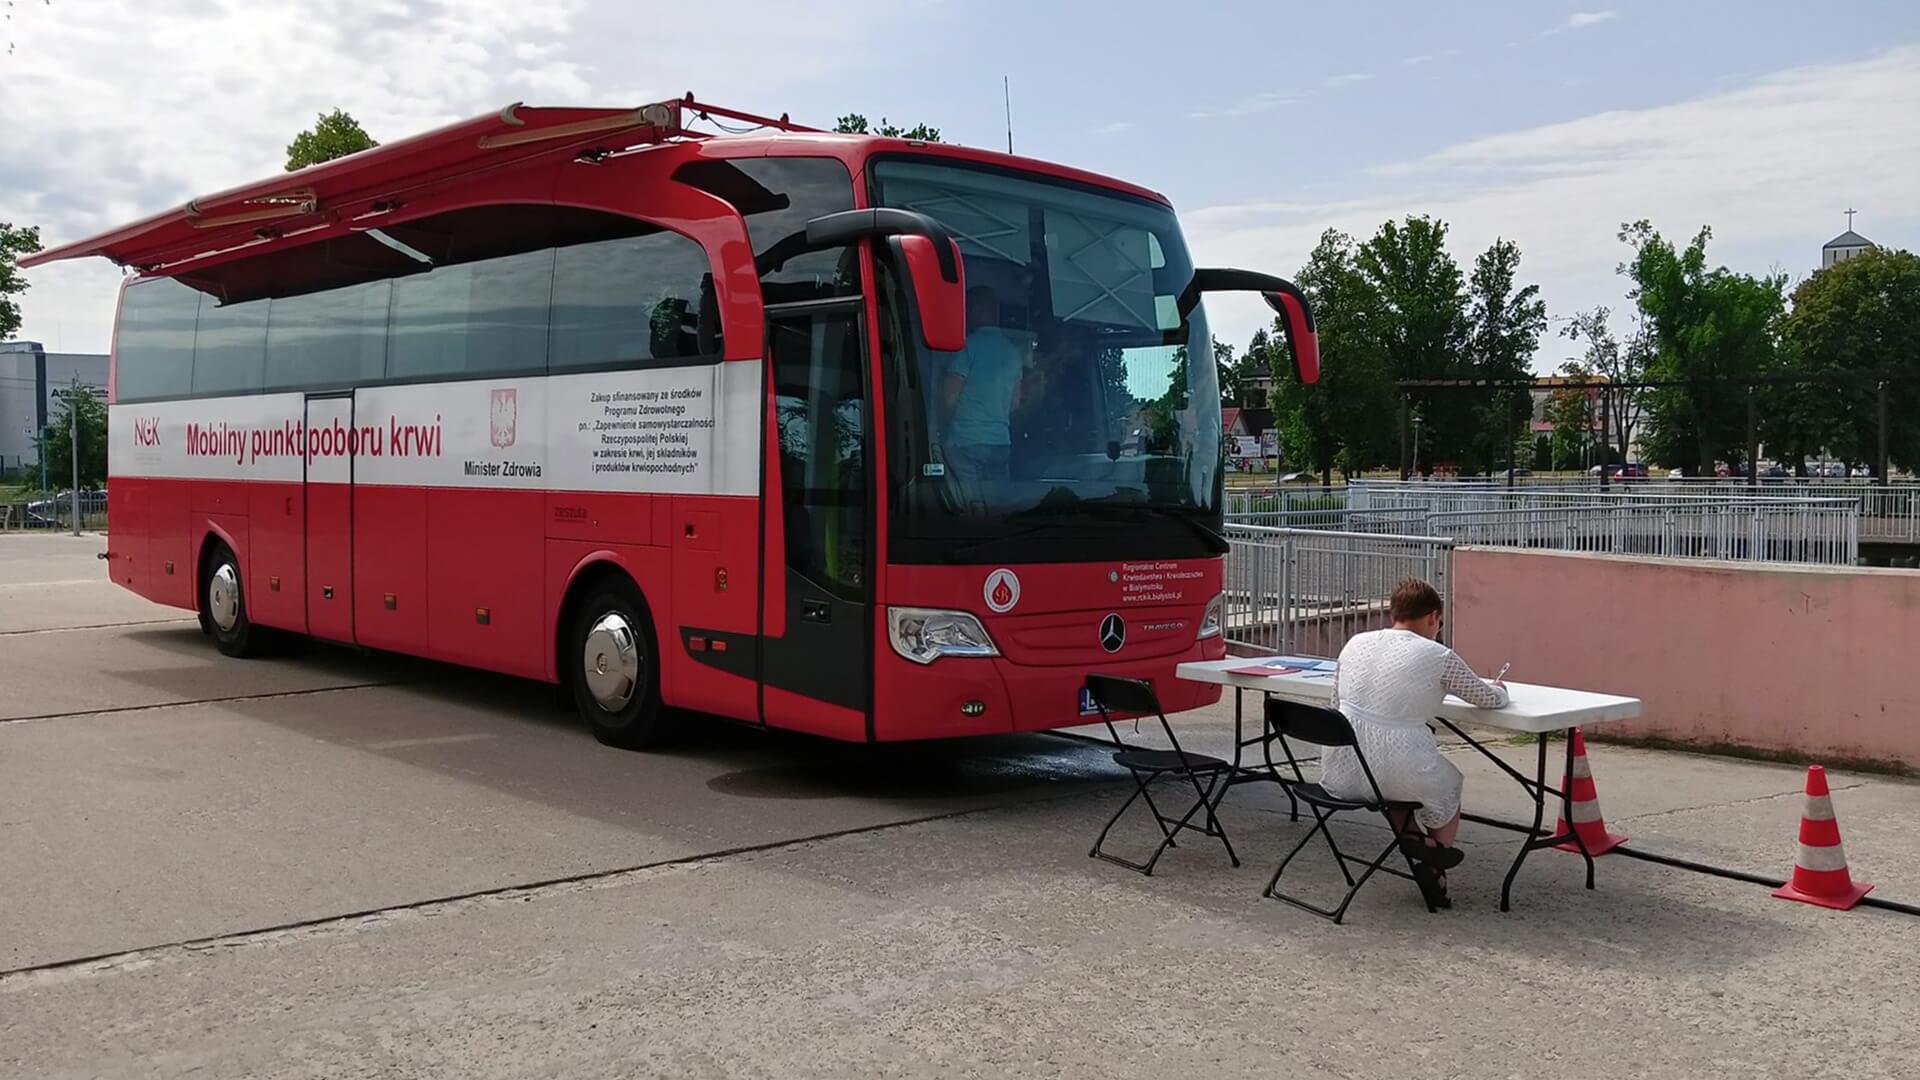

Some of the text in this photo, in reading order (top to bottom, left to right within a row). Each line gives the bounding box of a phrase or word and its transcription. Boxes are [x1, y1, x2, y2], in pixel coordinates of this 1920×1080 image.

[590, 388, 702, 403] Zakup sfinansowany ze środków
[604, 404, 686, 418] Programu Zdrowotnego
[187, 413, 441, 466] Mobilny punkt poboru krwi
[601, 432, 689, 446] Rzeczypospolitej Polskiej
[592, 450, 599, 458] w
[600, 448, 628, 458] zakresie
[628, 448, 645, 459] krwi,
[646, 448, 656, 460] jej
[464, 460, 542, 477] Minister Zdrowia
[595, 461, 631, 474] produktów
[1122, 563, 1155, 573] Regionalne
[1122, 572, 1163, 581] Krwiodawstwa
